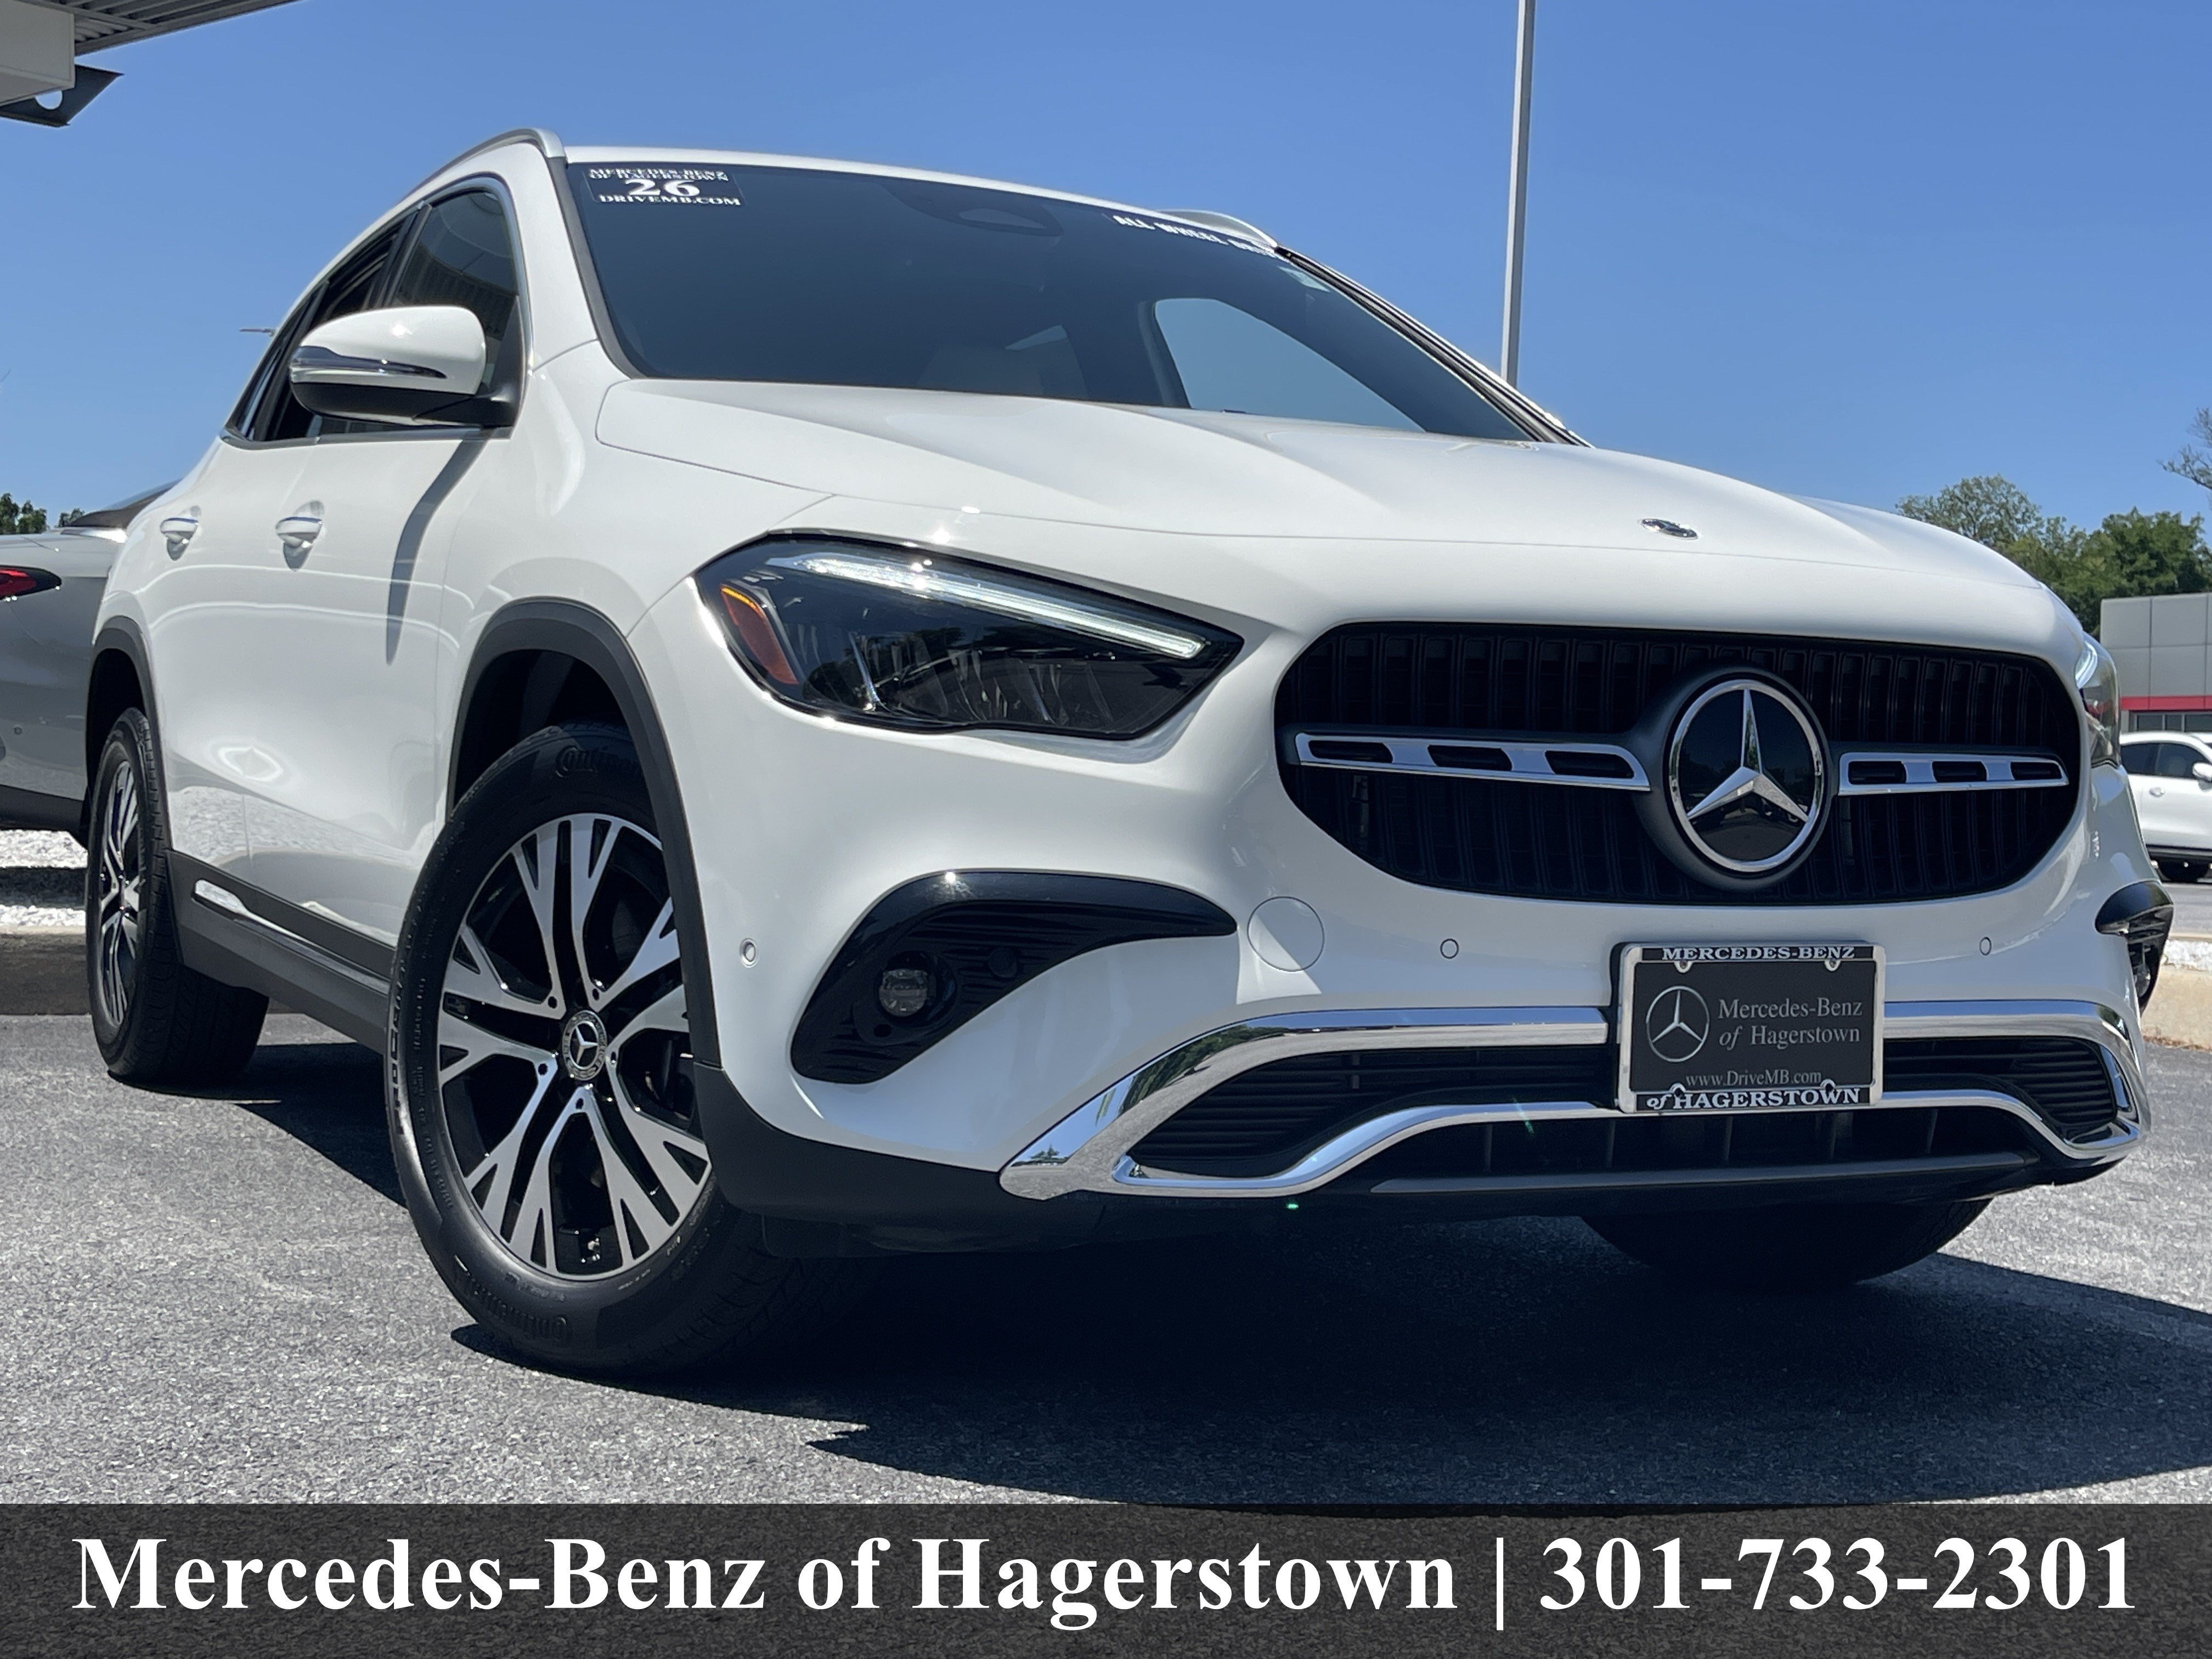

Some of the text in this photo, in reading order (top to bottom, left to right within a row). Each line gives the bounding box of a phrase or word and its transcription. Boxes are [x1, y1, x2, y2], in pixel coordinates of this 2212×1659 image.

[624, 179, 700, 196] 26
[599, 194, 741, 205] DRIVEMB.COM
[1113, 215, 1155, 230] ALL
[1662, 946, 1855, 960] MERCEDES-BENZ
[1718, 997, 1863, 1019] Mercedes-Benz
[1719, 1025, 1860, 1050] of Hagerstown
[1685, 1069, 1822, 1086] www.DriveMB.com
[1646, 1088, 1861, 1110] of HAGERSTOWN
